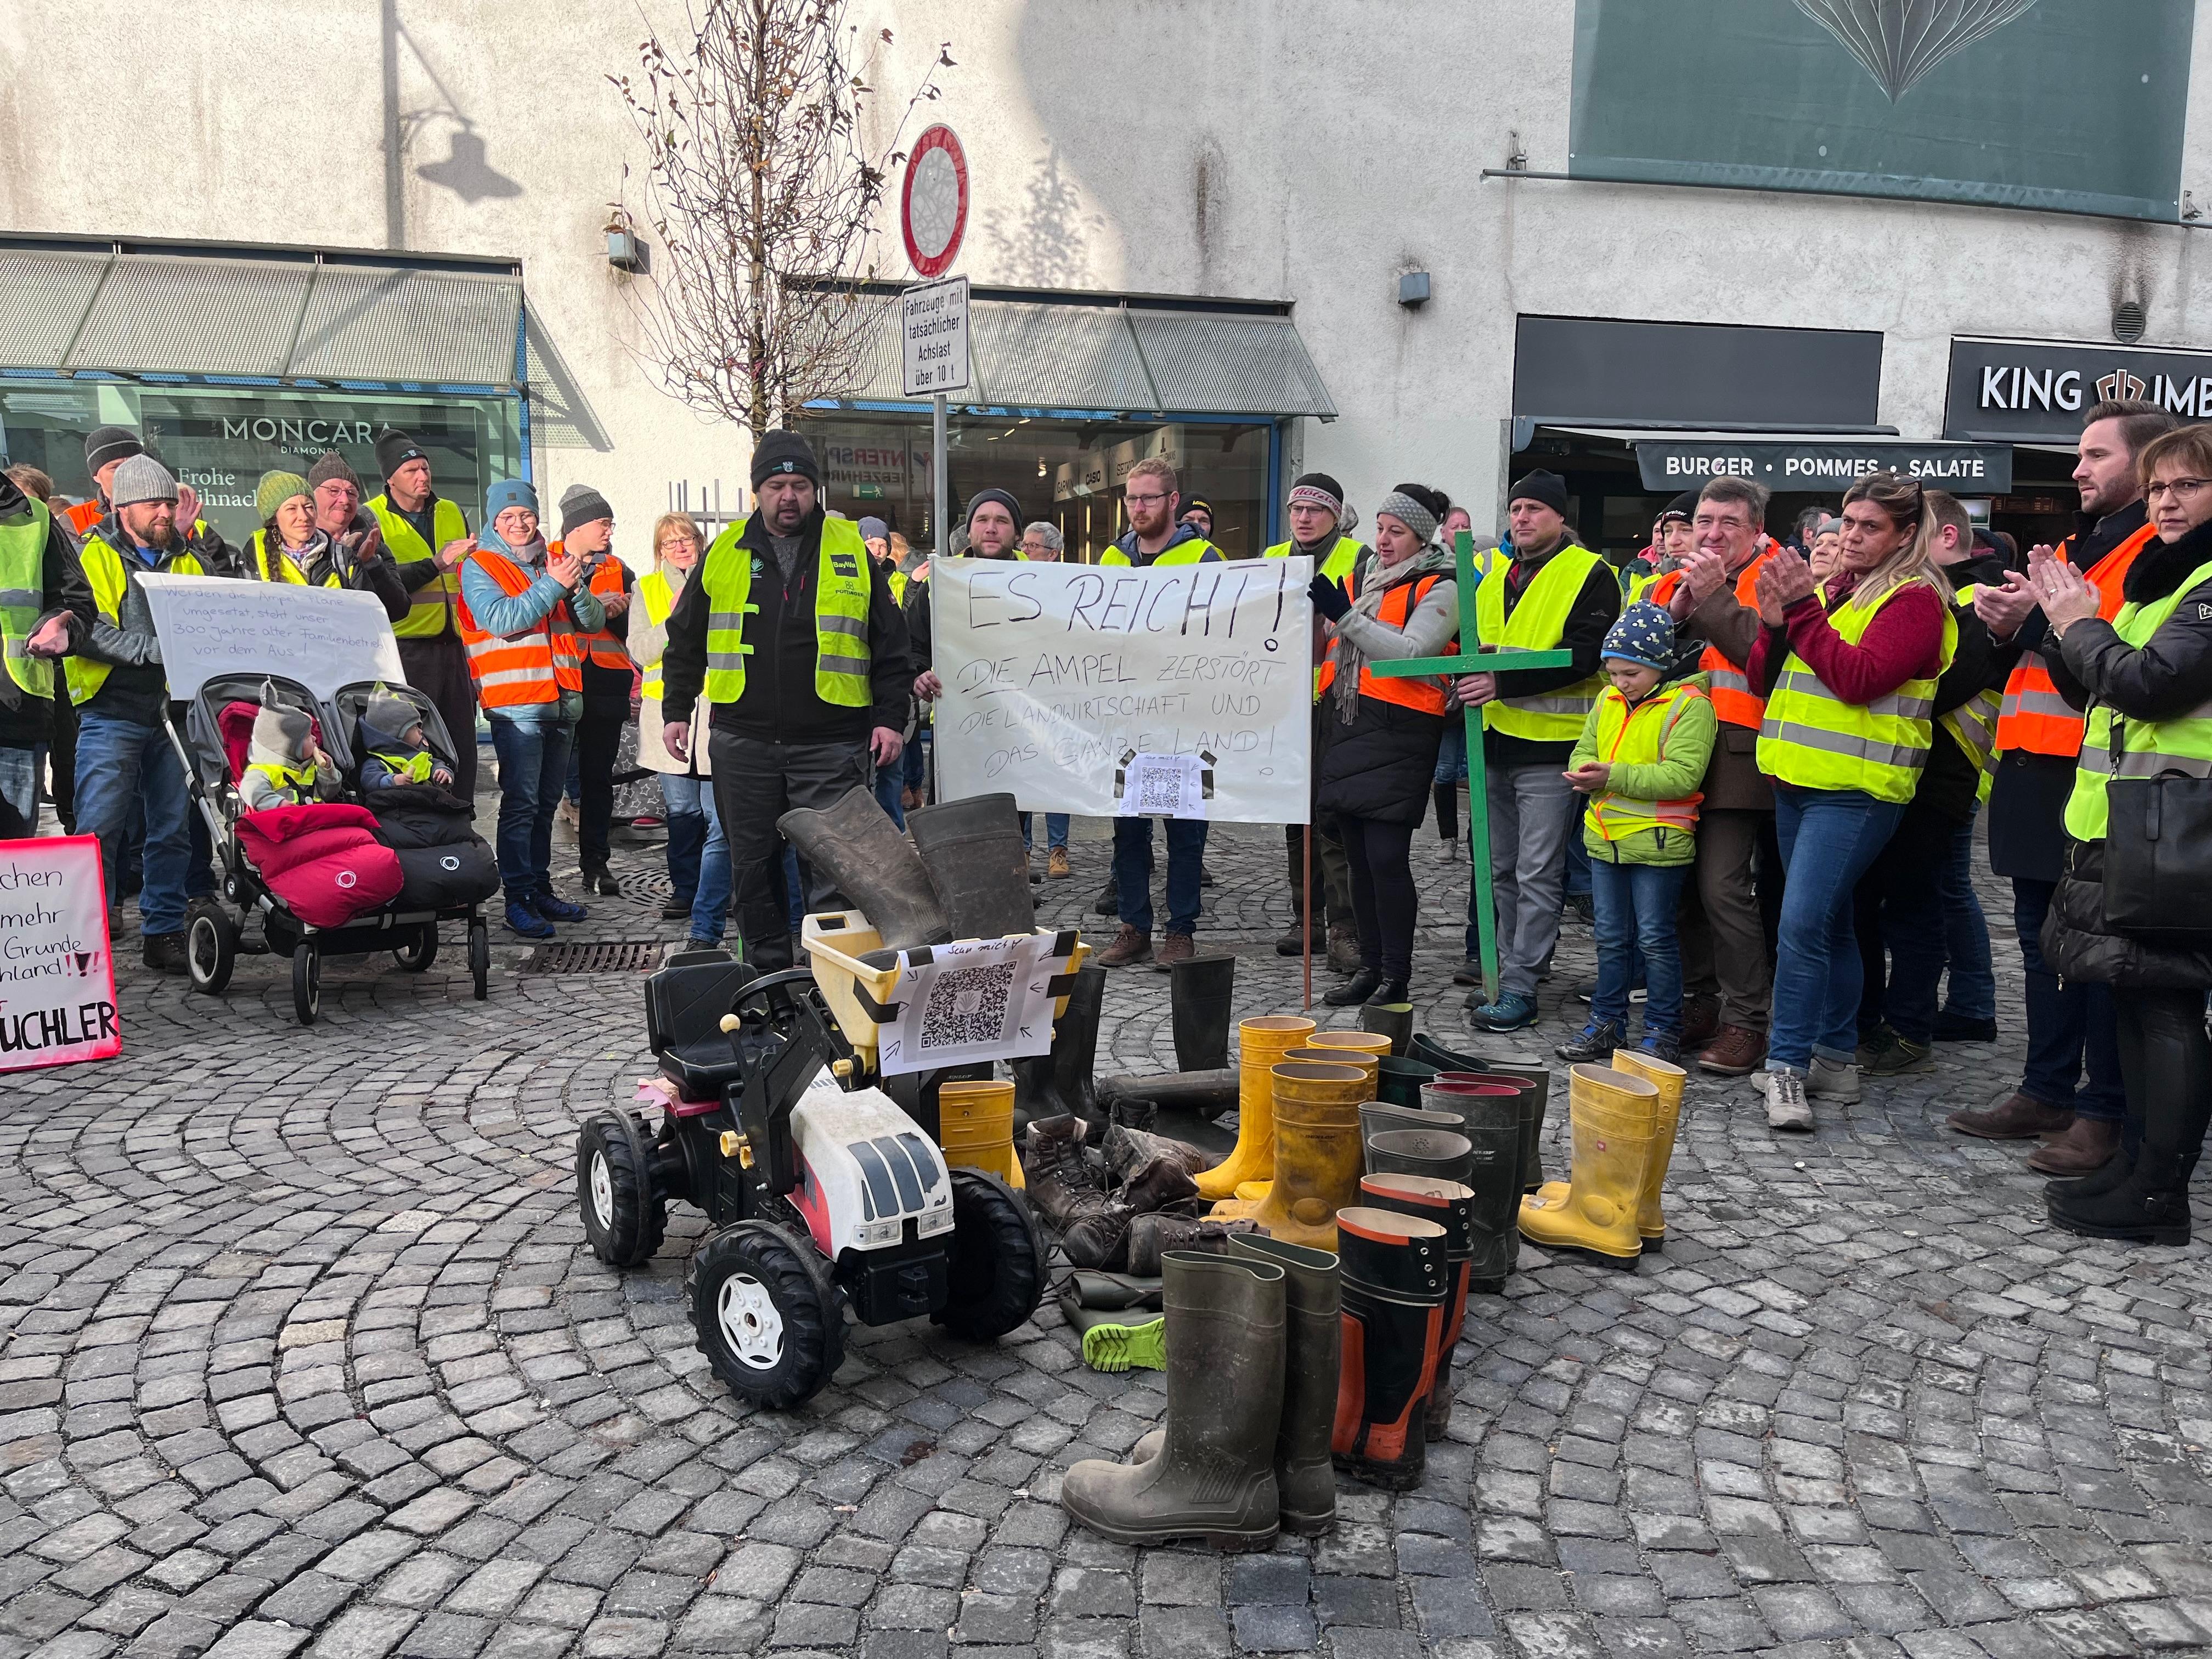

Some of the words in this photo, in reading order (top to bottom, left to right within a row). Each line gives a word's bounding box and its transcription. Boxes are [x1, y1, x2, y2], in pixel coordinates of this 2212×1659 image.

[906, 296, 944, 317] Fahrzeuge
[950, 287, 963, 306] mit
[909, 314, 960, 340] tatsächlicher
[918, 340, 951, 362] Achslast
[916, 370, 933, 386] über
[938, 364, 946, 382] 10
[951, 364, 955, 380] t
[1982, 365, 2083, 411] KING
[2153, 373, 2212, 417] IMB
[177, 467, 235, 486] Frohe
[1086, 470, 1101, 485] CASIO
[1116, 460, 1135, 476] SEIKO
[1666, 456, 1754, 476] BURGER
[1785, 457, 1879, 477] POMMES
[1909, 459, 1984, 478] SALATE
[198, 488, 257, 507] ihnac
[166, 586, 221, 597] Werden
[229, 590, 246, 599] die
[970, 572, 1042, 629] ES
[258, 610, 287, 619] steht
[296, 614, 328, 624] unser
[173, 623, 205, 634] 300
[211, 625, 256, 641] Jahre
[263, 627, 292, 637] alter
[194, 646, 219, 656] vor
[229, 644, 257, 655] dem
[957, 657, 1019, 694] DIE
[1029, 653, 1137, 686] AMPEL
[1158, 651, 1286, 684] ZERSTÖRT
[959, 710, 1000, 735] DIE
[1005, 693, 1190, 727] LANDWIRTSCHAFT
[1212, 695, 1261, 716] UND
[985, 743, 1039, 777] DAS
[1053, 733, 1153, 767] GANZE
[0, 862, 62, 890] chen
[1, 902, 66, 929] mehr
[4, 934, 86, 960] Grunde
[0, 951, 100, 983] hland!!!
[0, 1001, 119, 1052] UCHLER
